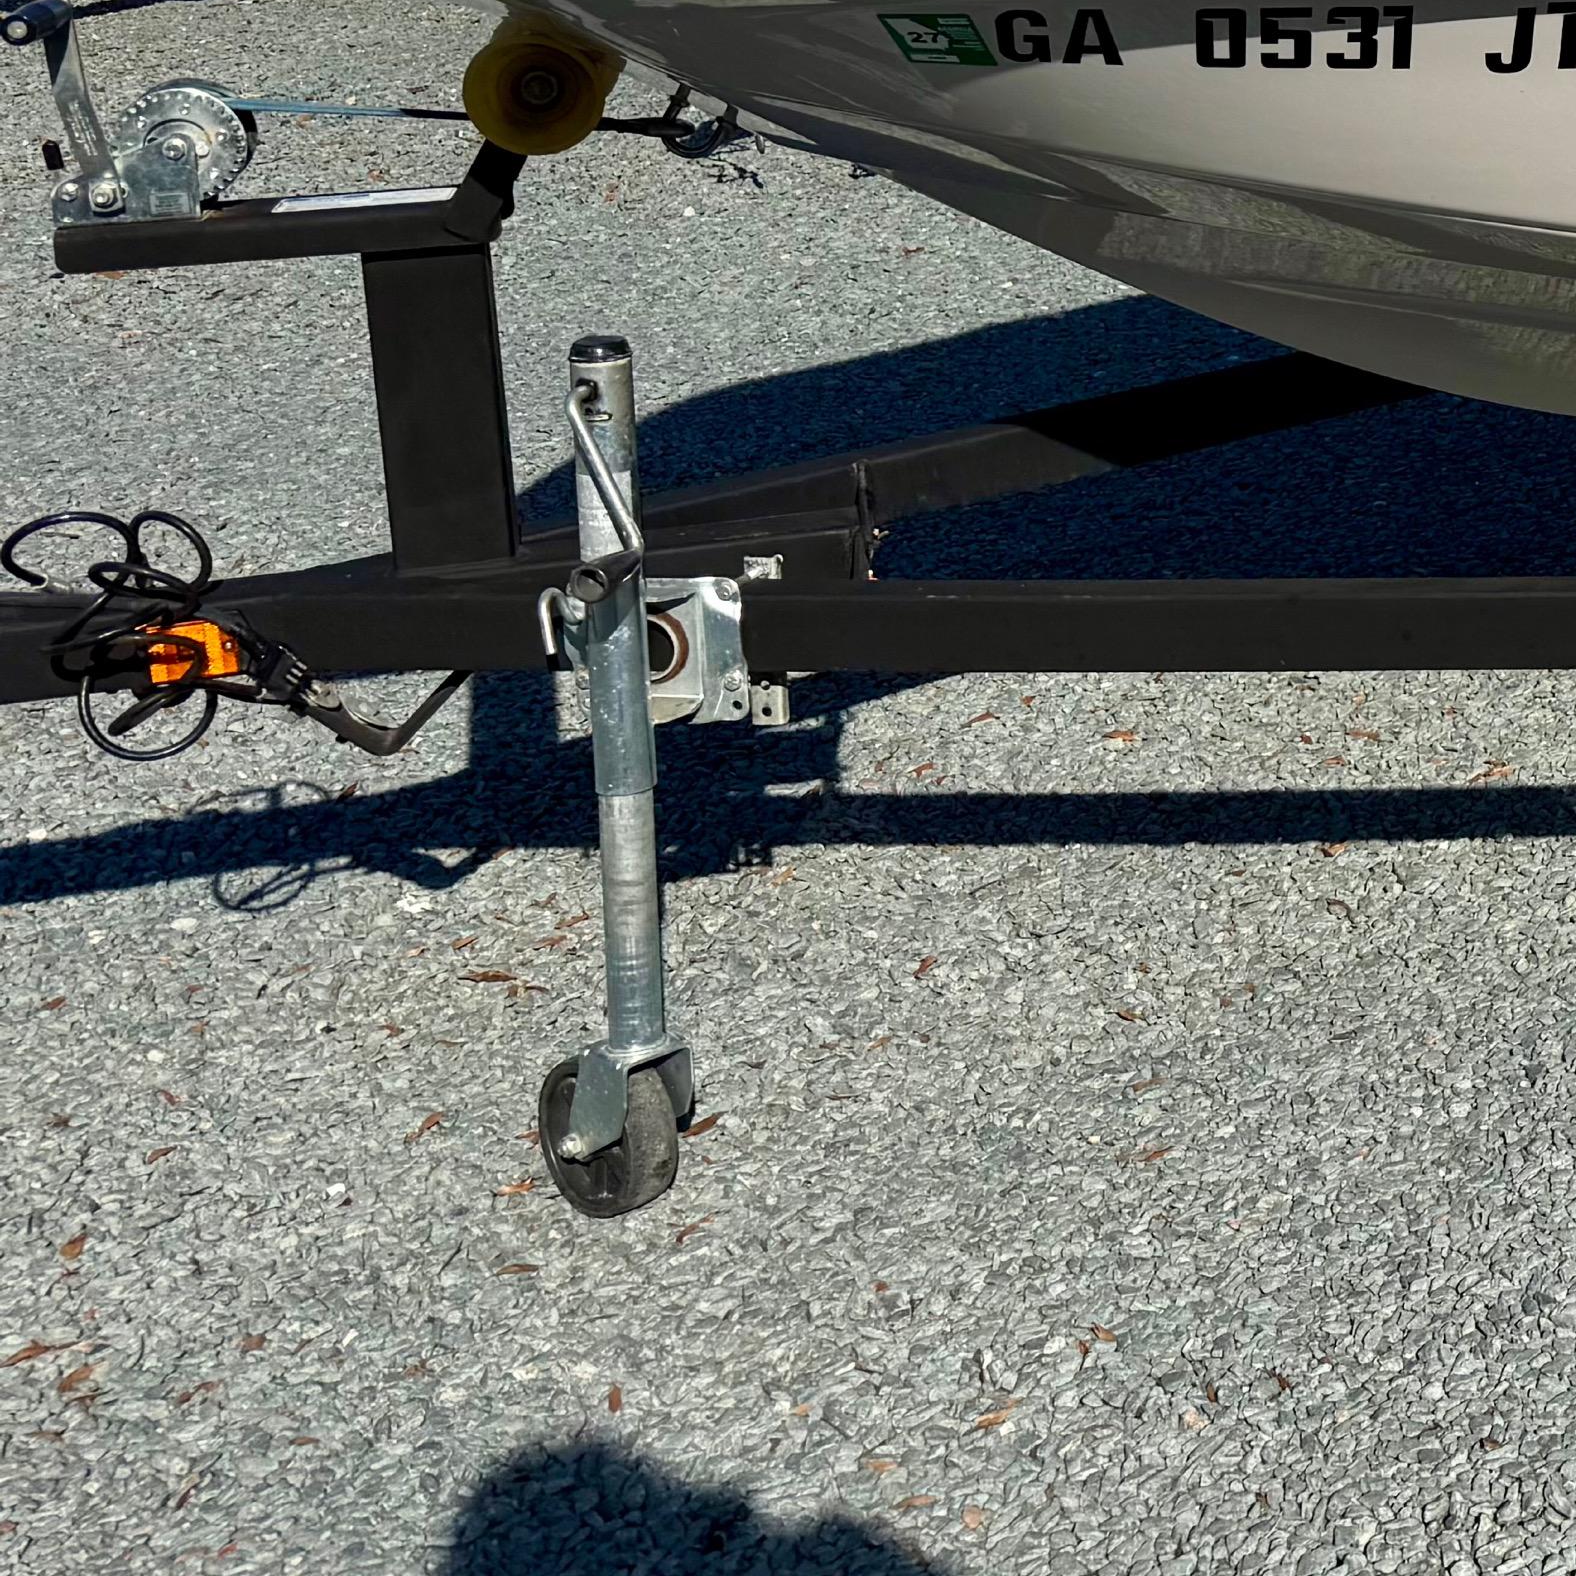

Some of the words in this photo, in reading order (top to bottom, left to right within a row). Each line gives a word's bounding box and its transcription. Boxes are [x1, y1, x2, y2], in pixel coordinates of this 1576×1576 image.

[907, 31, 939, 44] 27
[994, 8, 1123, 66] GA
[1195, 5, 1414, 70] 0531
